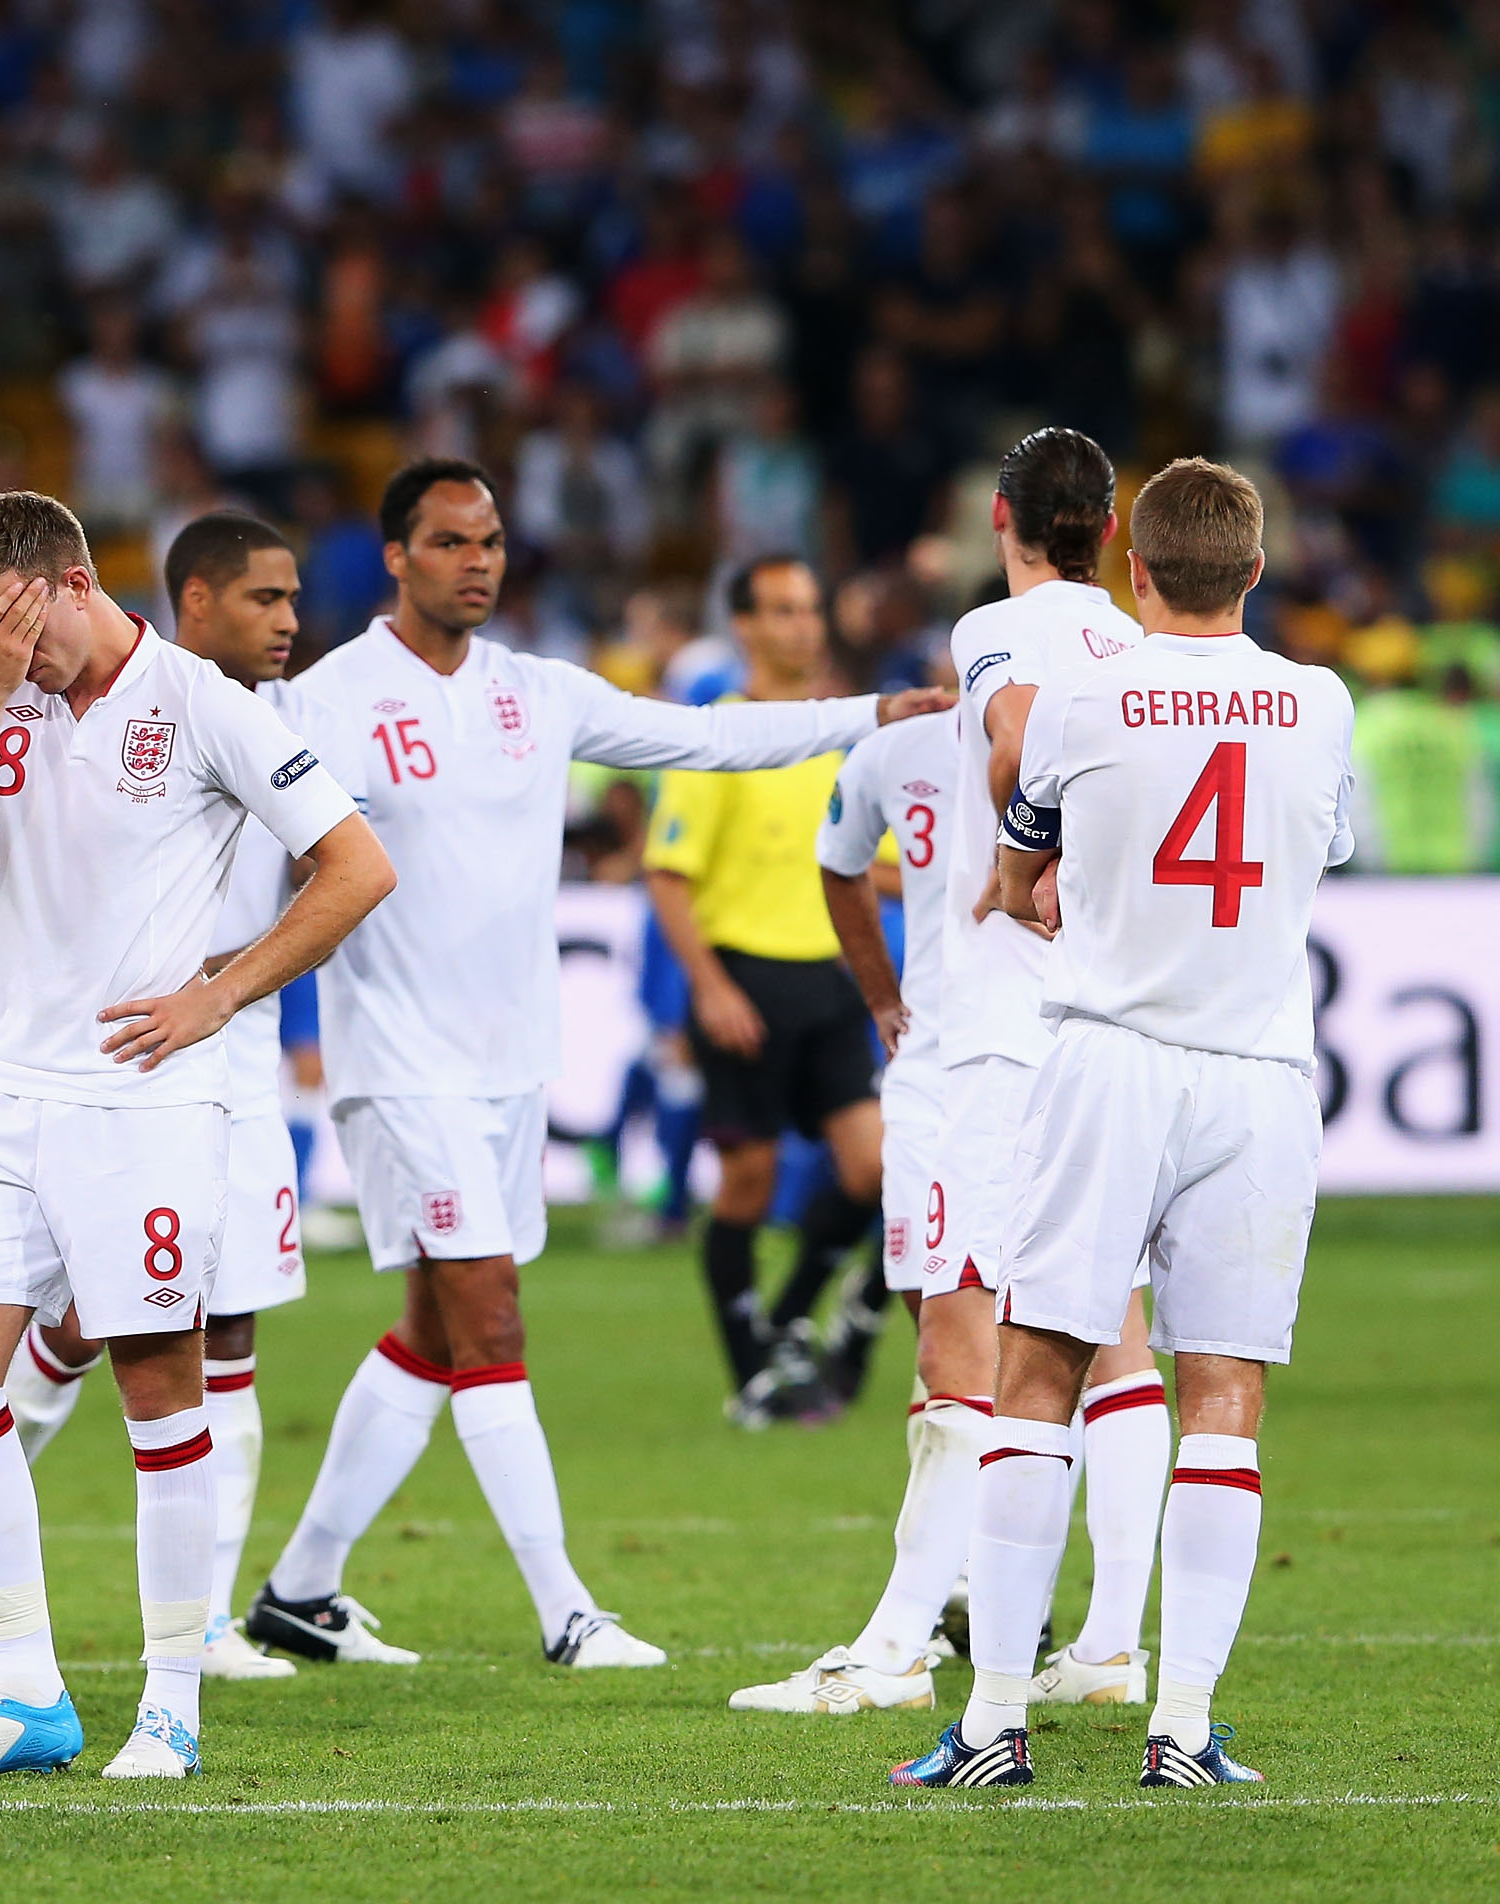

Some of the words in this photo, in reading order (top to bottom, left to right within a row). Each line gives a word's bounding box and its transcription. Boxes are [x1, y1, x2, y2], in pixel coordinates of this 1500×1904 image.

[969, 653, 1008, 678] RESPECT
[1121, 690, 1298, 728] GERRARD
[372, 719, 437, 785] 15
[905, 803, 936, 869] 3
[1152, 741, 1264, 929] 4
[144, 1207, 183, 1281] 8
[276, 1187, 297, 1254] 2
[926, 1181, 945, 1250] 9
